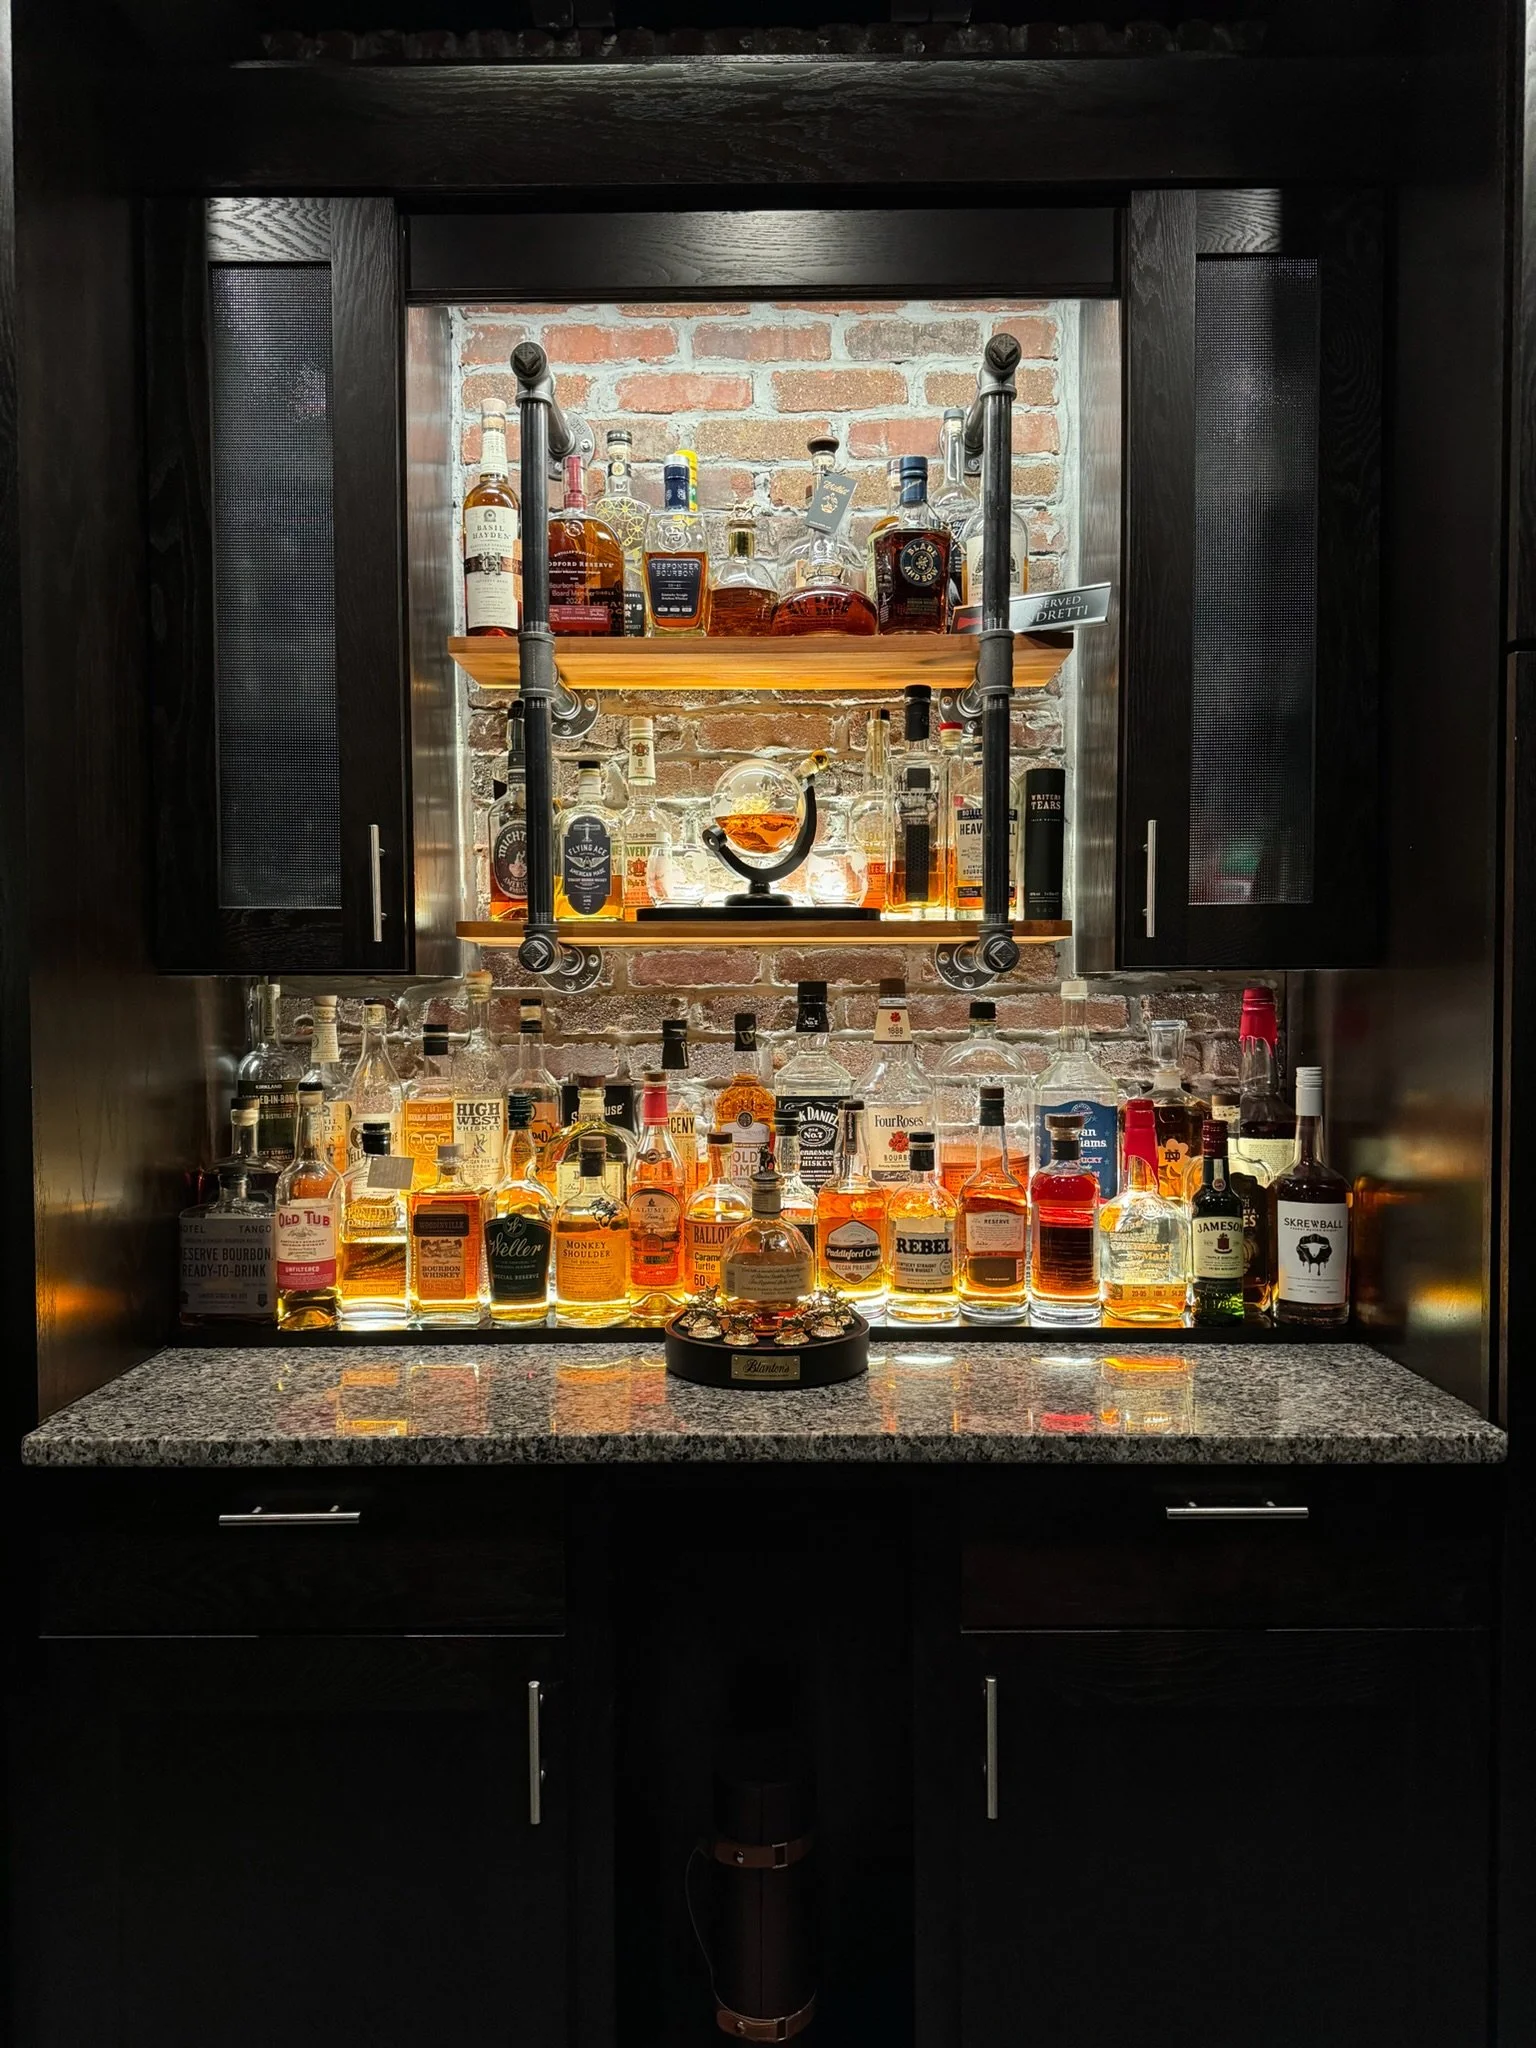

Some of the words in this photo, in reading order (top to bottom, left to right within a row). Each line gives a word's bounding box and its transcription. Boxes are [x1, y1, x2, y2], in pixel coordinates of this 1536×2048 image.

[472, 532, 510, 540] HAYDEN
[907, 542, 938, 558] BLADE
[904, 566, 921, 582] AND
[921, 567, 939, 582] BOW
[1031, 801, 1061, 810] TEARS
[568, 844, 593, 855] FLYING
[594, 845, 607, 856] ACE
[888, 1026, 903, 1034] 1888
[457, 1103, 500, 1116] HIGH
[457, 1116, 500, 1126] WEST
[279, 1212, 300, 1228] OLD
[304, 1210, 331, 1226] TUB
[1284, 1217, 1344, 1229] SKREWBALL
[239, 1224, 272, 1234] TANGO
[1197, 1222, 1243, 1234] JAMESON
[489, 1232, 545, 1257] Weller
[566, 1240, 607, 1250] MONKEY
[896, 1237, 952, 1255] REBEL
[563, 1249, 611, 1258] SHOULDER
[182, 1264, 267, 1278] READY-TO-DRINK
[285, 1265, 320, 1273] UNFILTERED
[695, 1262, 716, 1271] Turtle
[693, 1273, 706, 1287] 60
[743, 1358, 790, 1374] Blanton's
